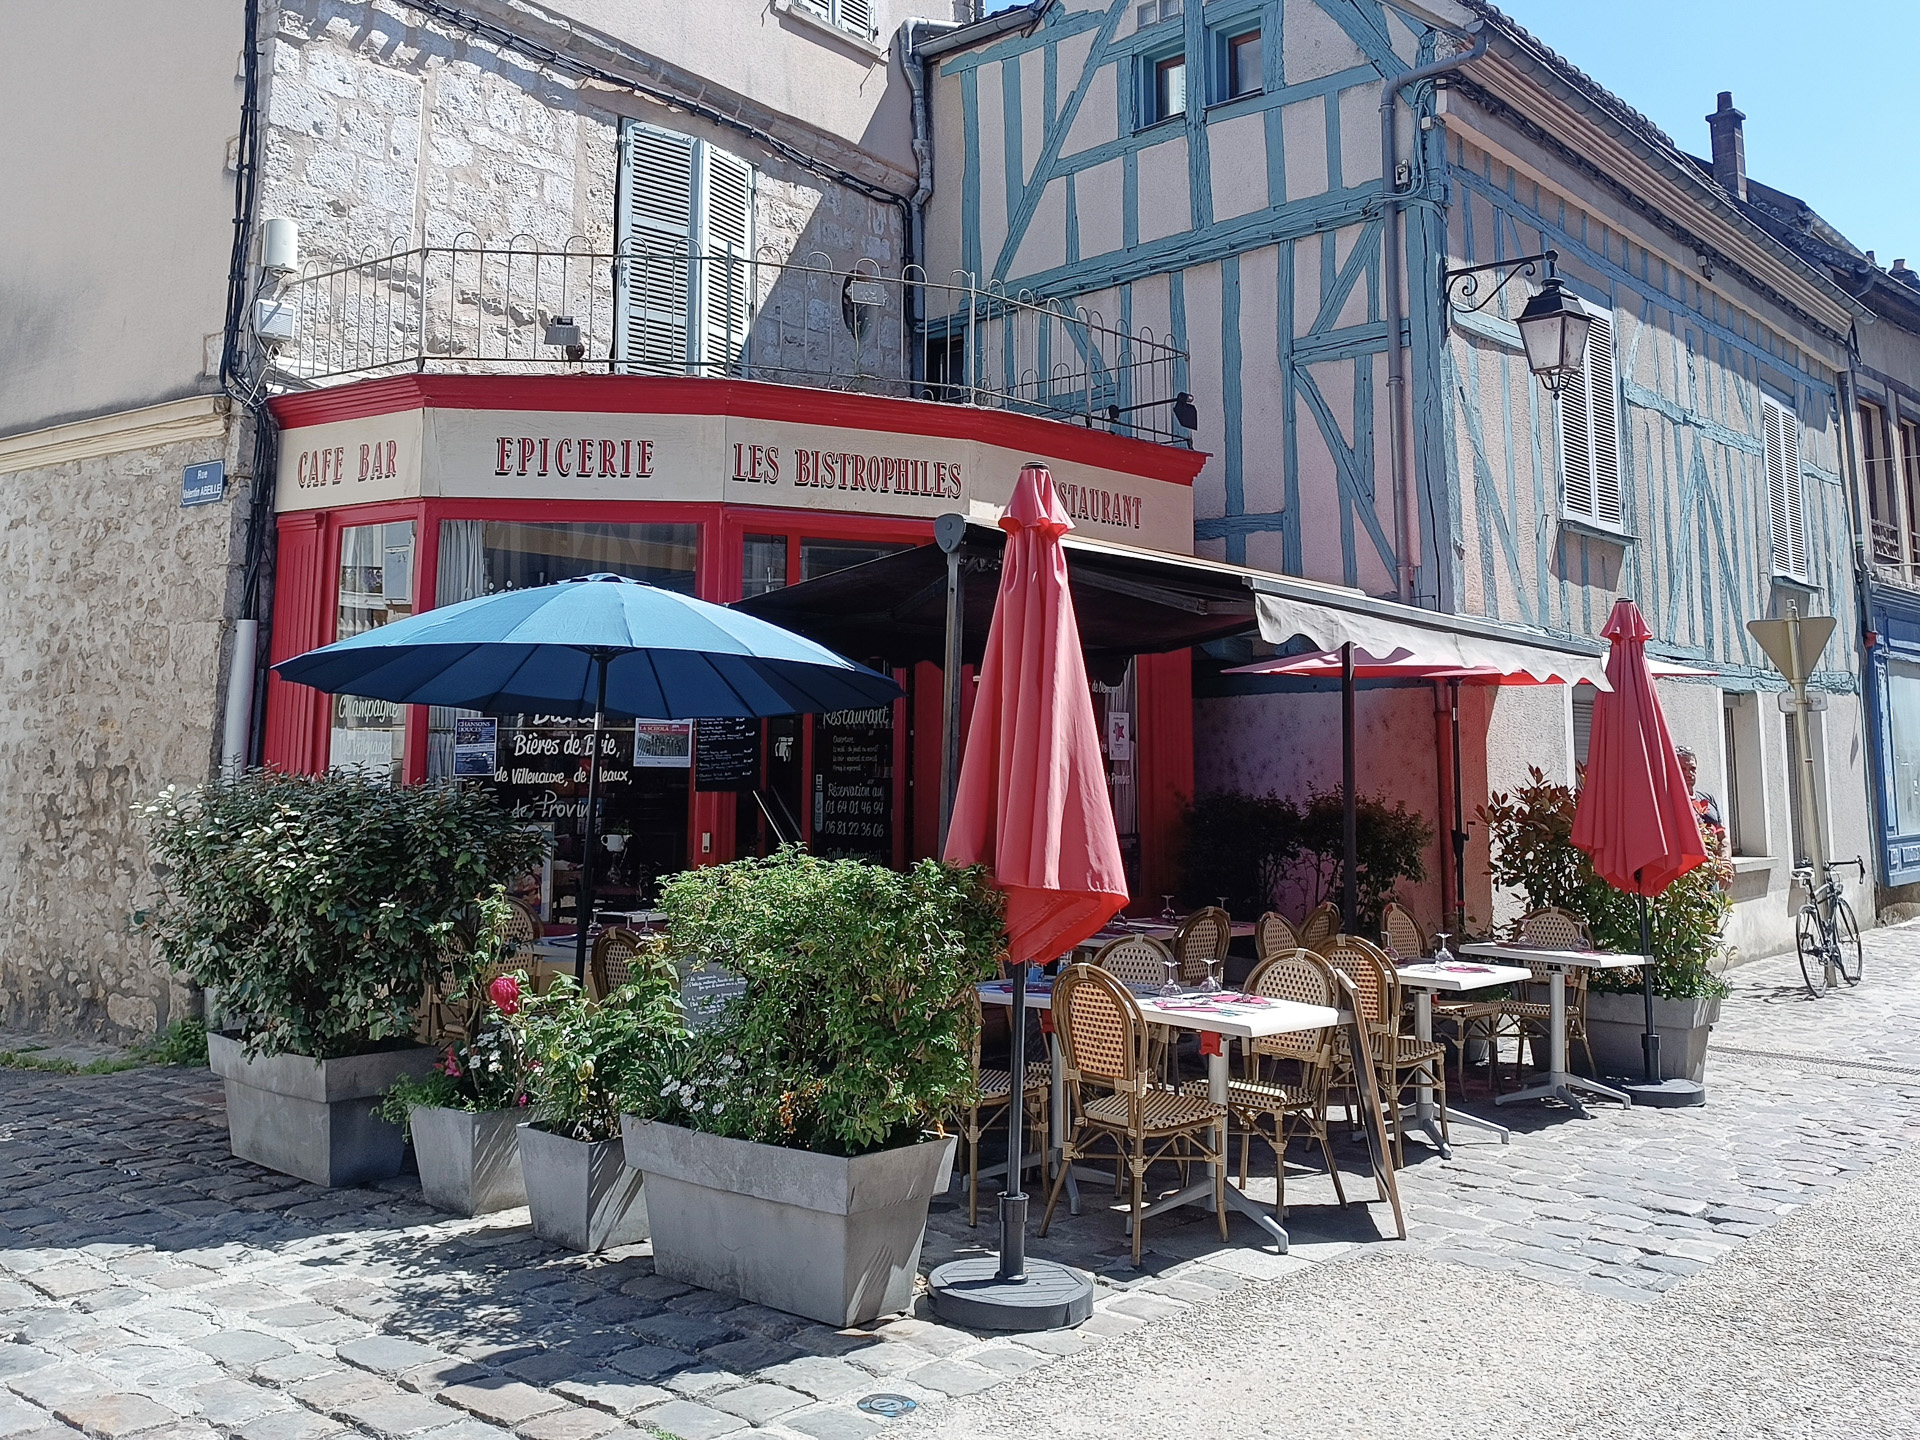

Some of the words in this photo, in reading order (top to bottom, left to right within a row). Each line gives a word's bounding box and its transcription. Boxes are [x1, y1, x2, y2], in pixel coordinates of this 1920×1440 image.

[297, 447, 345, 488] CAFE
[357, 440, 398, 482] BAR
[495, 437, 655, 479] EPICERIE
[197, 469, 208, 480] Rue
[732, 442, 780, 485] LES
[794, 448, 963, 499] BISTROPHILES
[200, 484, 221, 496] ABEILLE
[1053, 480, 1142, 529] STAURANT
[513, 732, 559, 756] Bières
[563, 733, 582, 751] de
[494, 766, 508, 783] de
[511, 767, 568, 787] Villenauxe,
[573, 766, 587, 783] de
[825, 800, 835, 814] 01
[837, 800, 848, 813] 64
[849, 800, 859, 814] 01
[861, 801, 872, 814] 46
[873, 801, 884, 814] 94
[825, 820, 836, 834] 06
[836, 820, 847, 836] 81
[848, 821, 860, 836] 22
[860, 822, 872, 836] 36
